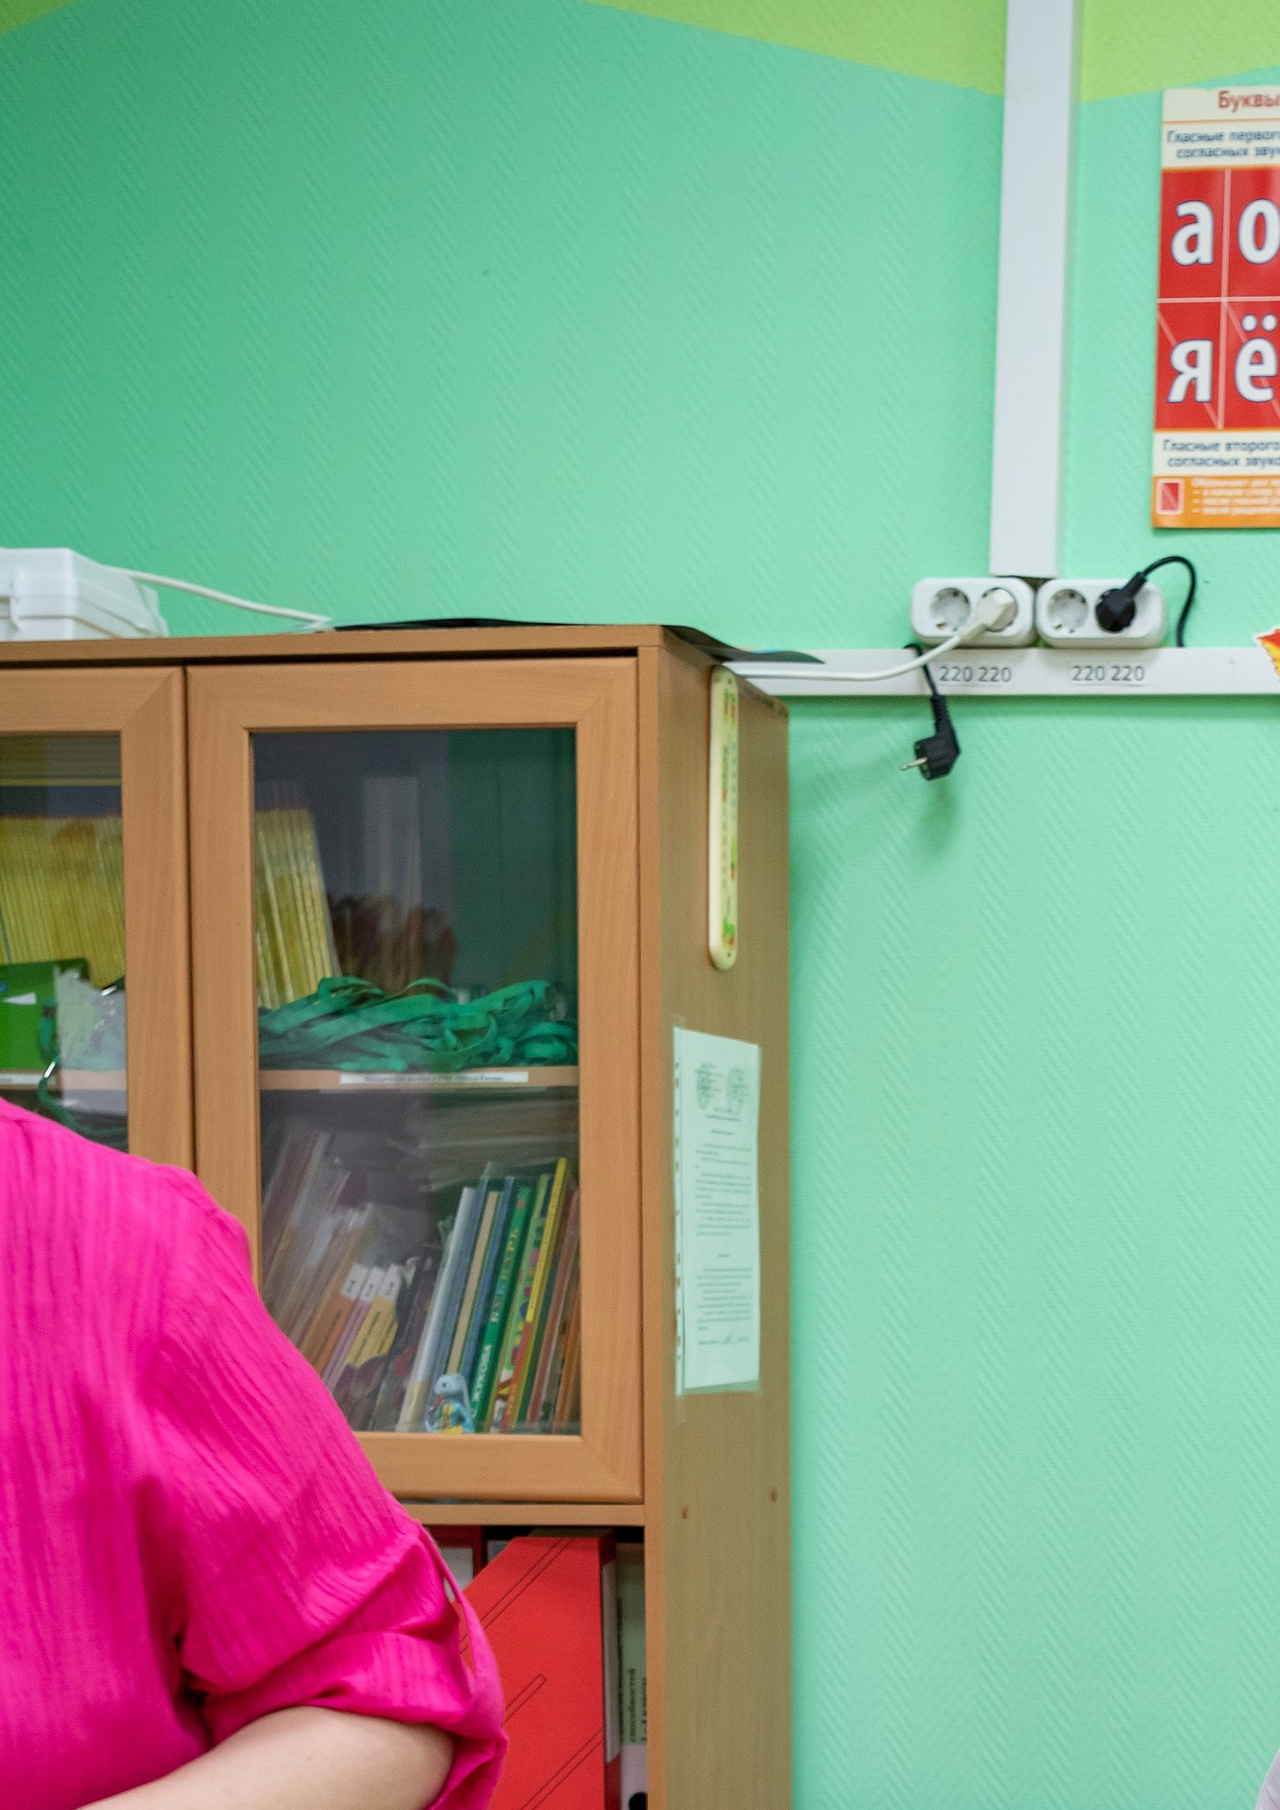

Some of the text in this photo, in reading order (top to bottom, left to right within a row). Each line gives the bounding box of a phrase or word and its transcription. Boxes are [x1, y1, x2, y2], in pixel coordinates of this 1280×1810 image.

[1218, 89, 1280, 113] Буквы
[940, 666, 1012, 683] 220 220
[1072, 665, 1145, 682] 220 220
